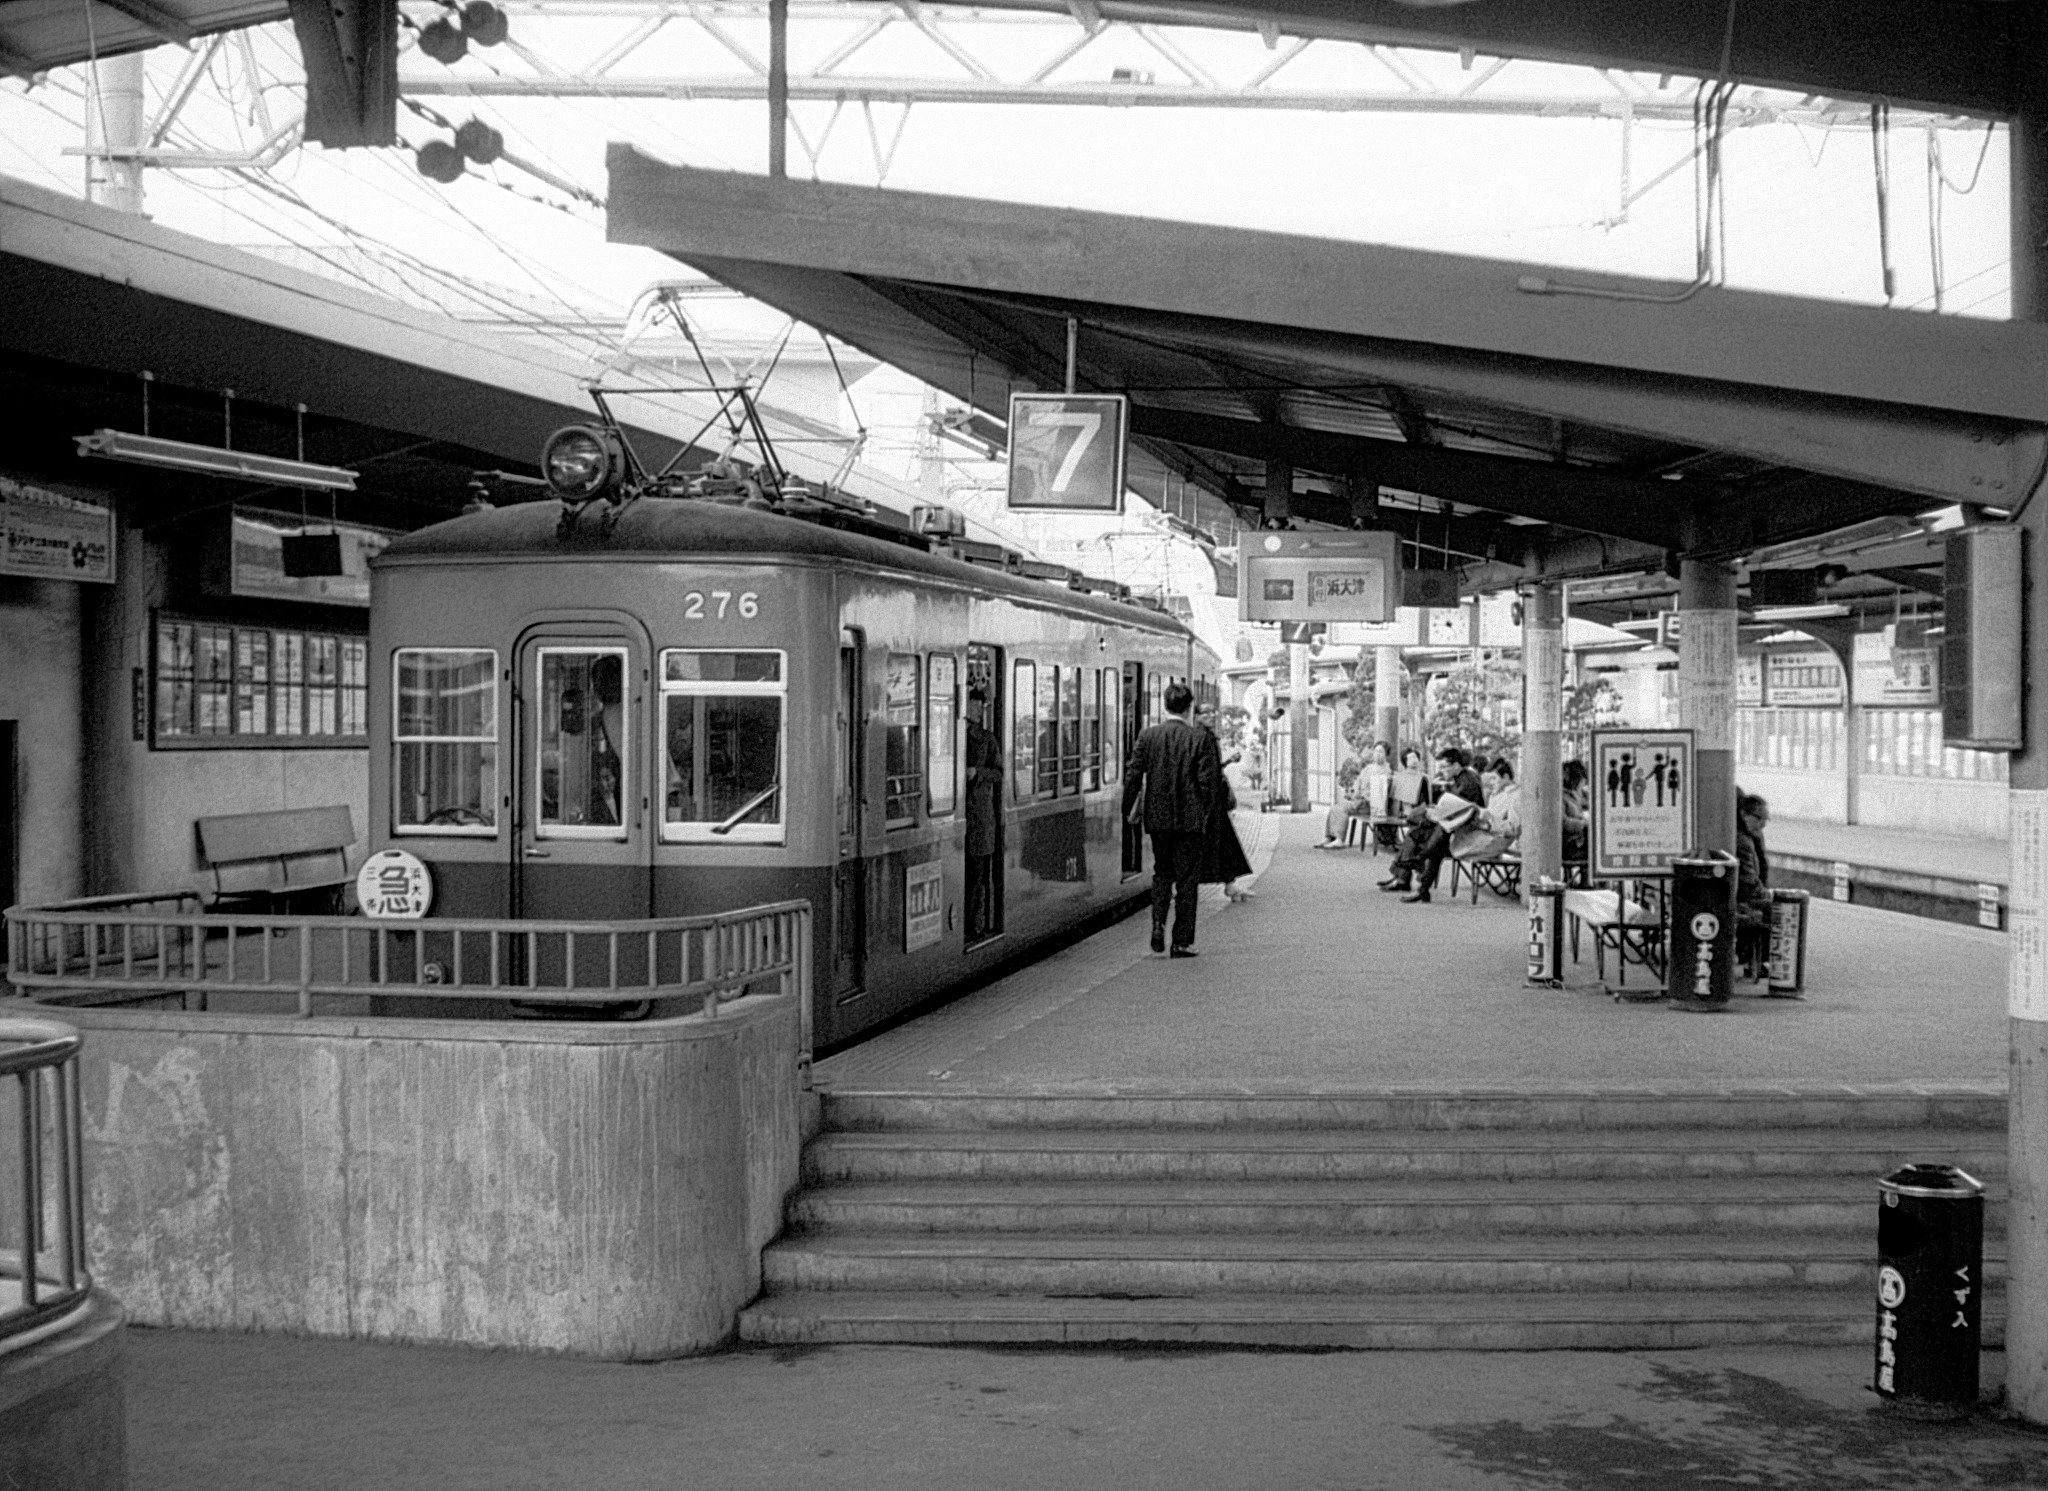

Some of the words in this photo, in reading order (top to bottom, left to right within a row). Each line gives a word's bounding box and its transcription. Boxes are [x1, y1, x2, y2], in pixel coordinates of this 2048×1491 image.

[1028, 412, 1102, 492] 7
[684, 591, 759, 619] 276
[1327, 577, 1366, 597] 浜大津
[378, 866, 411, 915] 急
[411, 867, 422, 913] 浜大津
[1951, 1265, 1971, 1329] くず入
